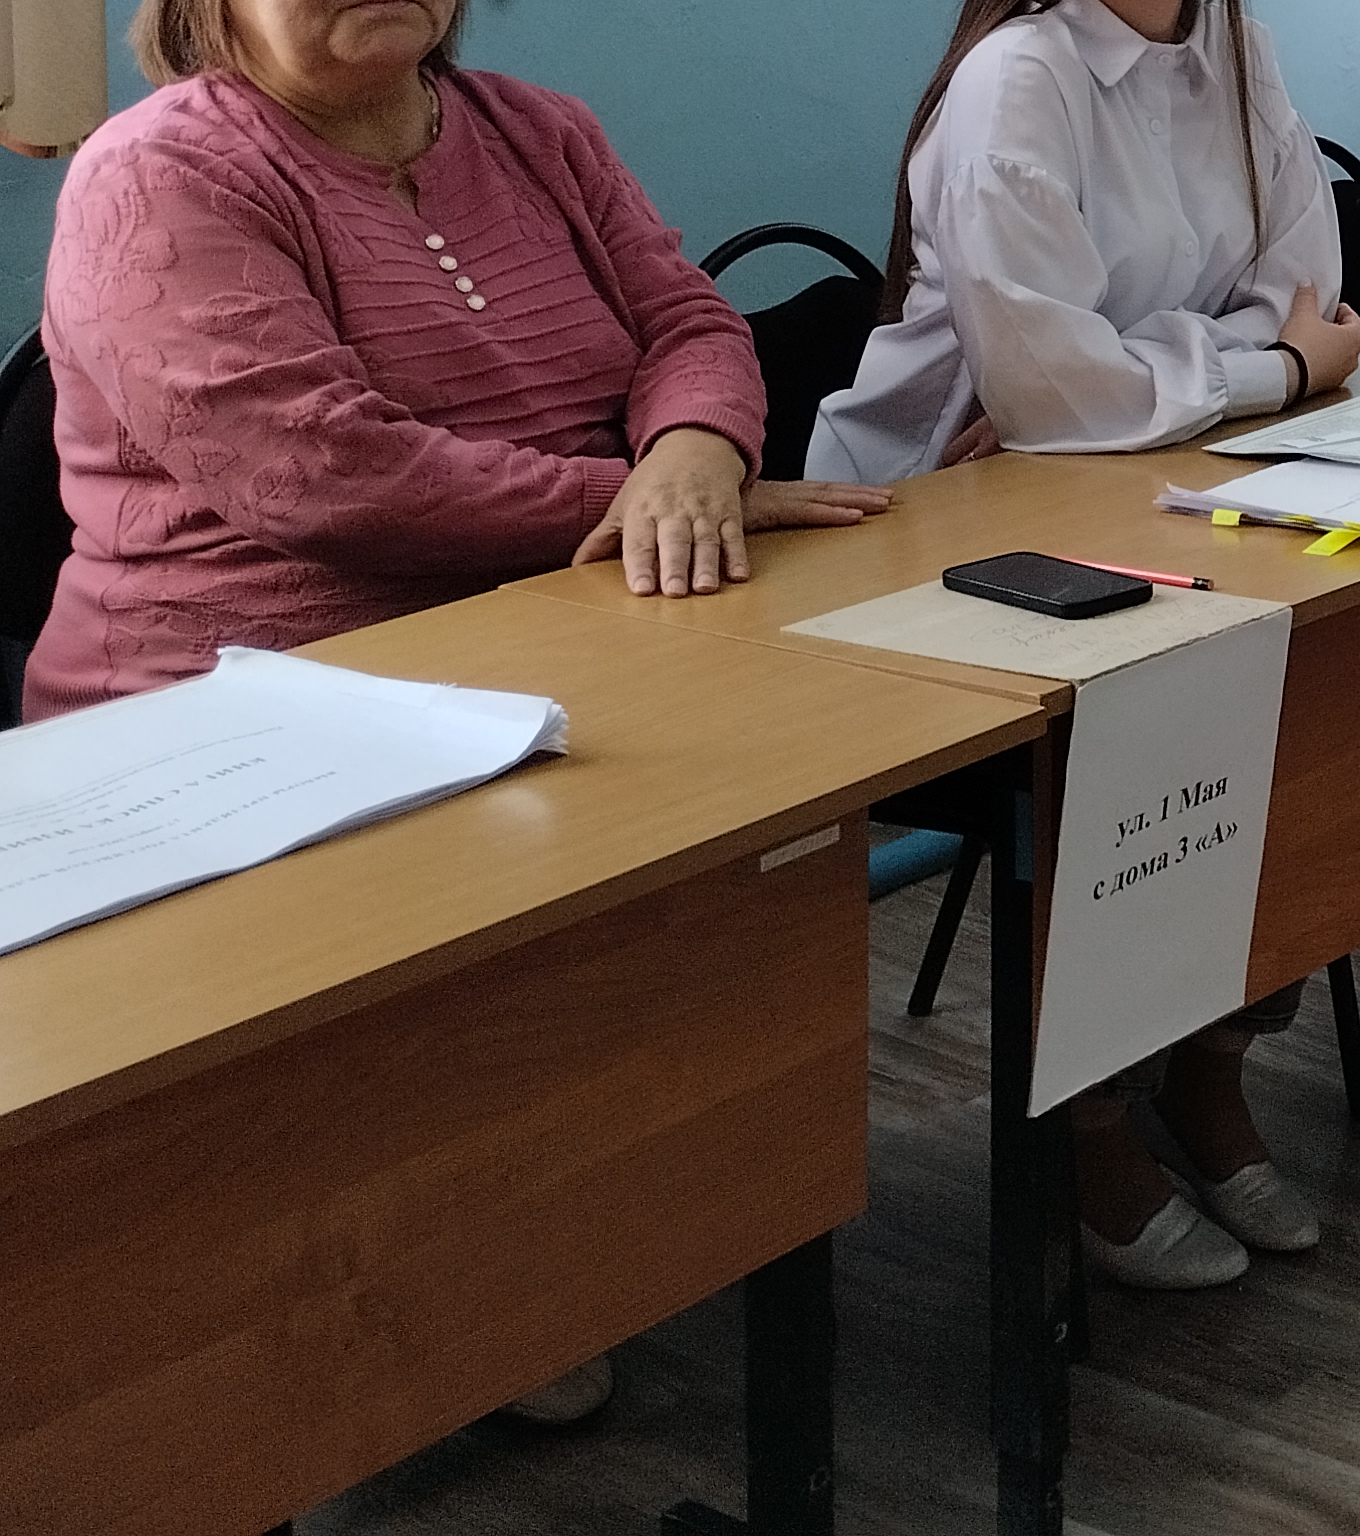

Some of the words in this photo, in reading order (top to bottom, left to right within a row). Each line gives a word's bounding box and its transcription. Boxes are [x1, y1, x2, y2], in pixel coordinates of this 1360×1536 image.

[1115, 813, 1150, 848] ул.
[1159, 795, 1169, 822] 1
[1178, 777, 1229, 814] Мая
[1093, 880, 1105, 900] с
[1110, 852, 1168, 897] дома
[1175, 836, 1188, 863] 3
[1195, 822, 1238, 852] «А»
